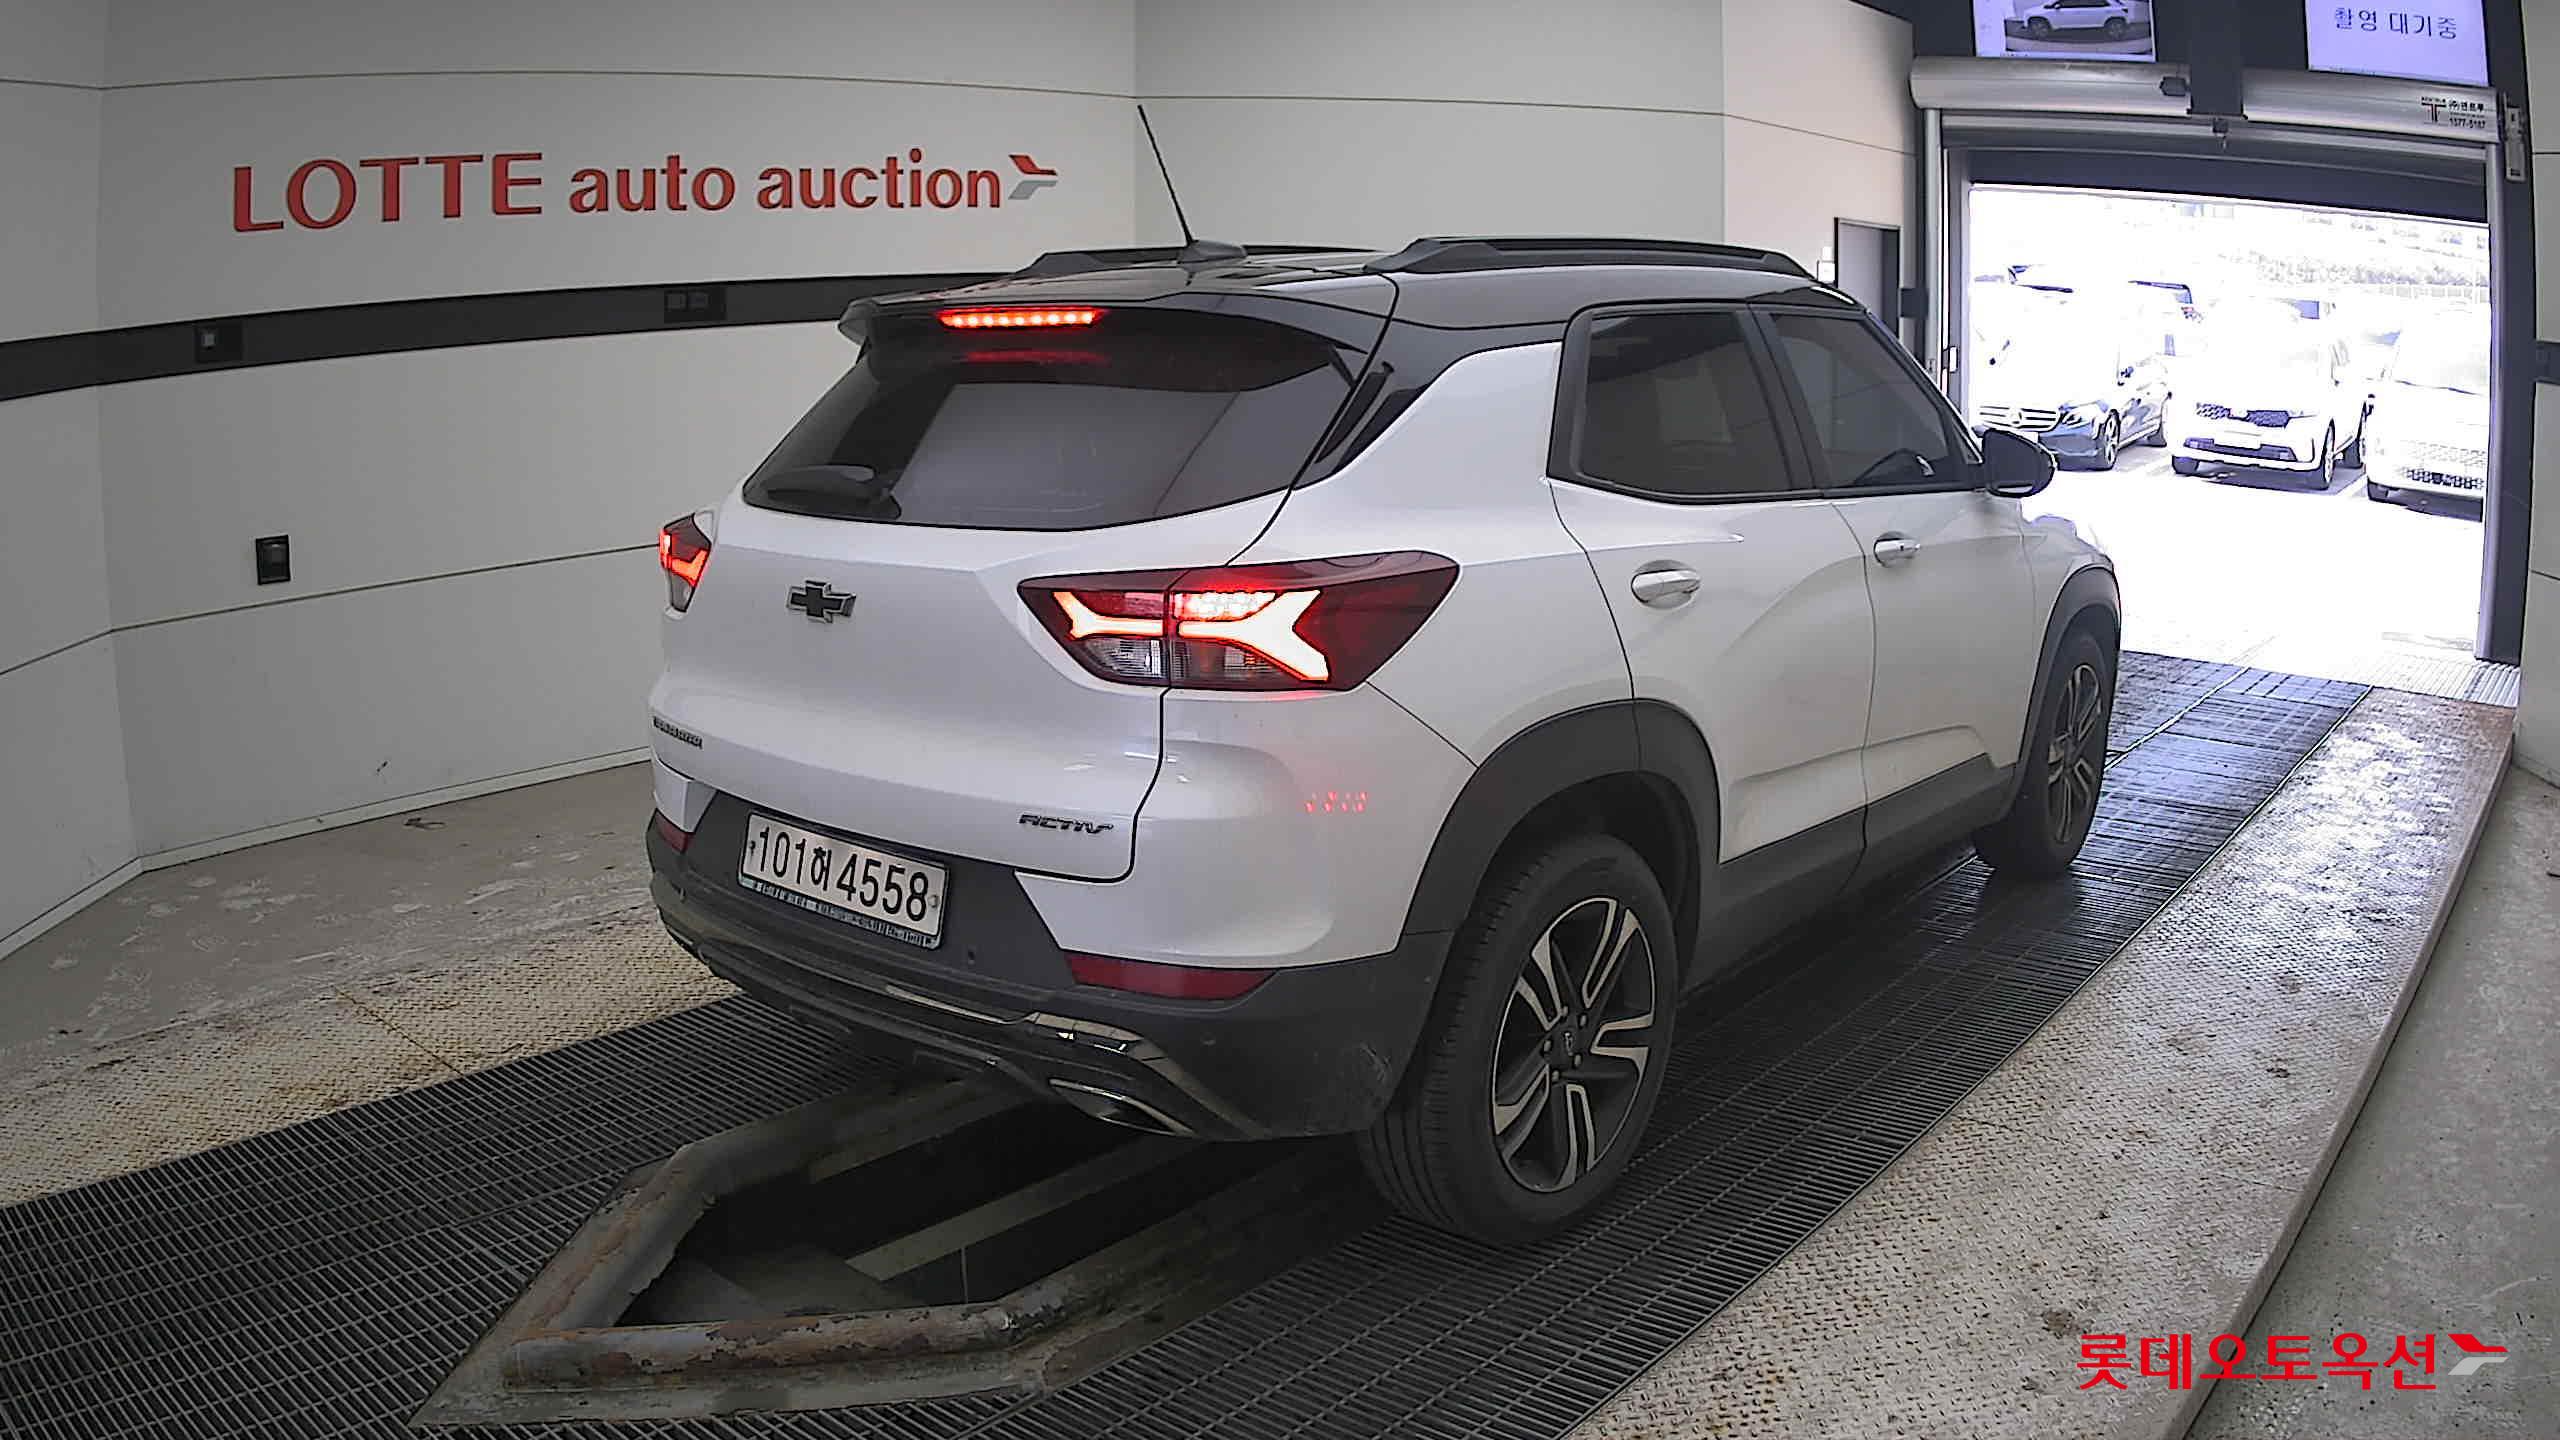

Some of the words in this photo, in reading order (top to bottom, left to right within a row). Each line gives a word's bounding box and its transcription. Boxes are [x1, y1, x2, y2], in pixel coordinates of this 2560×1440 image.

[233, 152, 543, 232] LOTTE
[569, 154, 736, 212] auto
[757, 147, 1001, 210] auction
